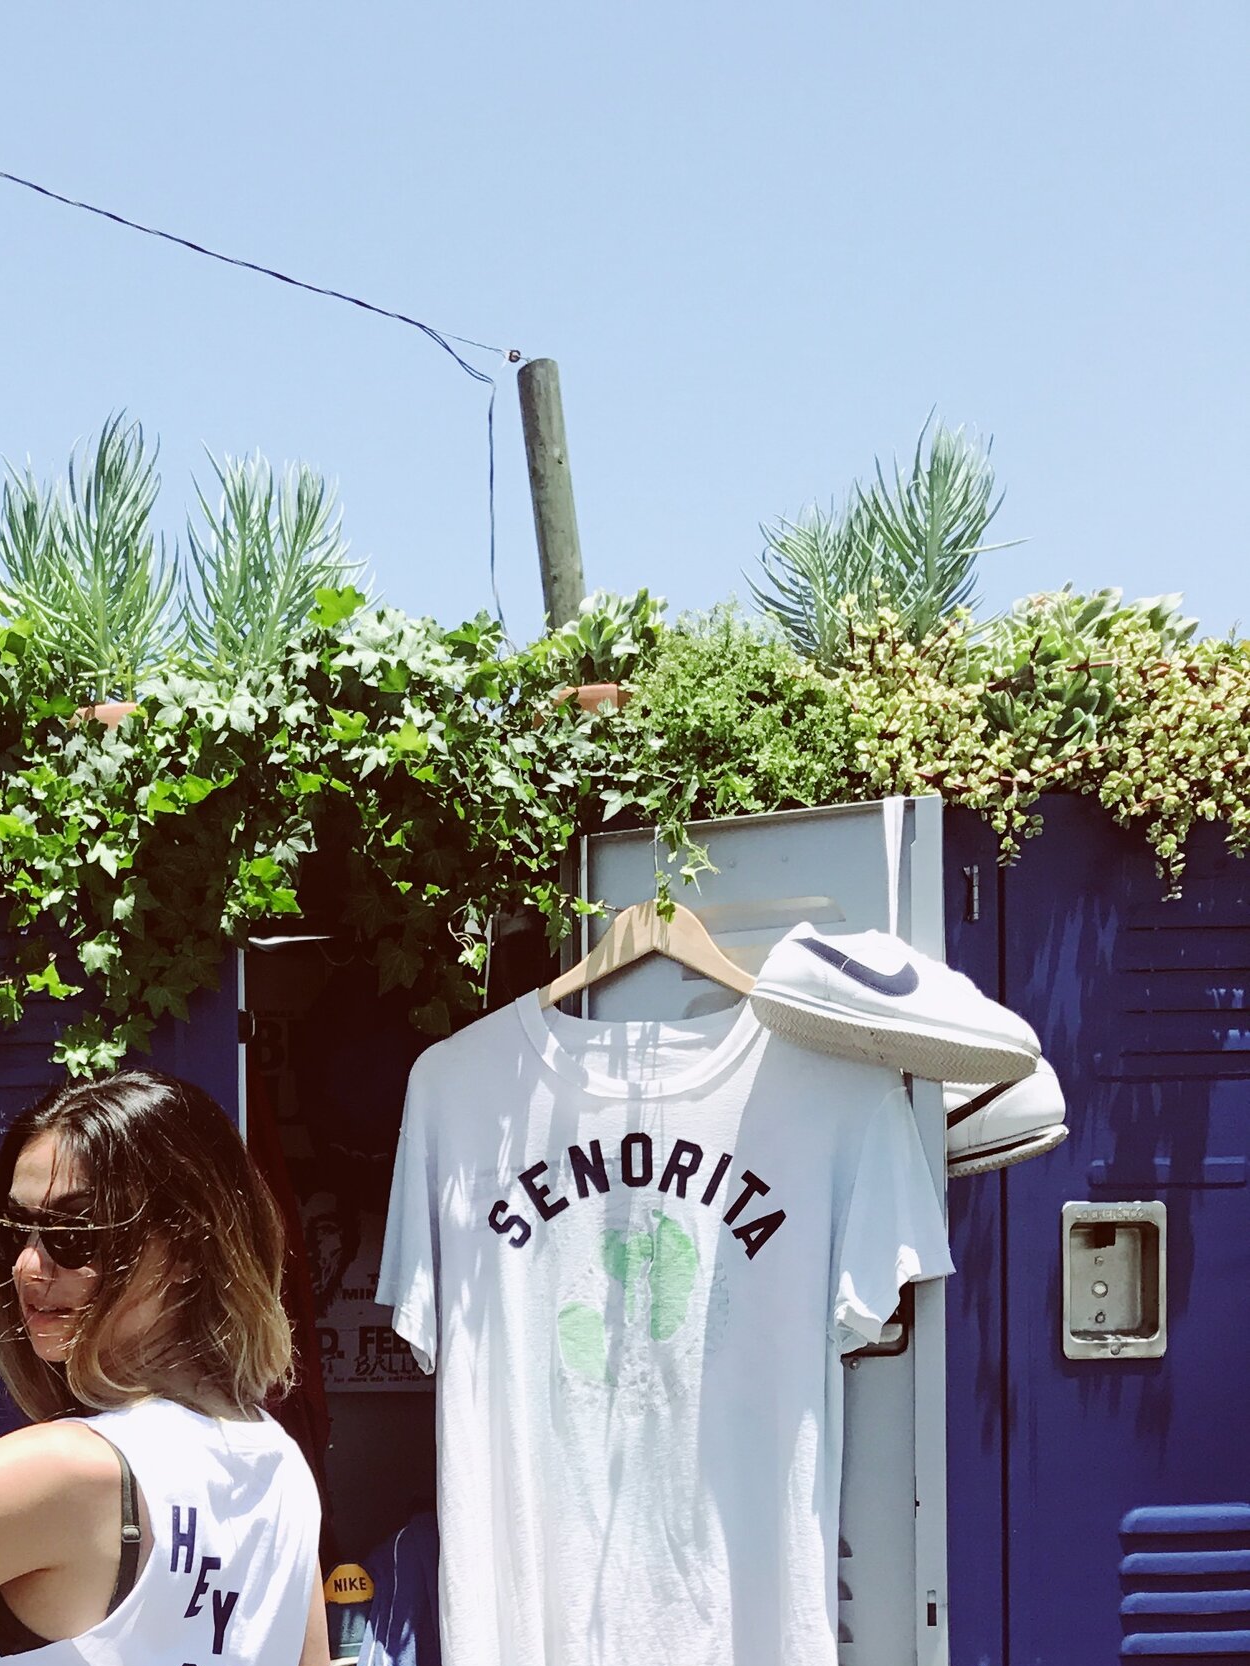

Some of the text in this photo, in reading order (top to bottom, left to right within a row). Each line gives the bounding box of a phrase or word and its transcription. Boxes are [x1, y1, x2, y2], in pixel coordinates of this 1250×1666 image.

[487, 1131, 788, 1261] SENORITA
[169, 1504, 240, 1656] HEY
[333, 1576, 368, 1593] NIKE
